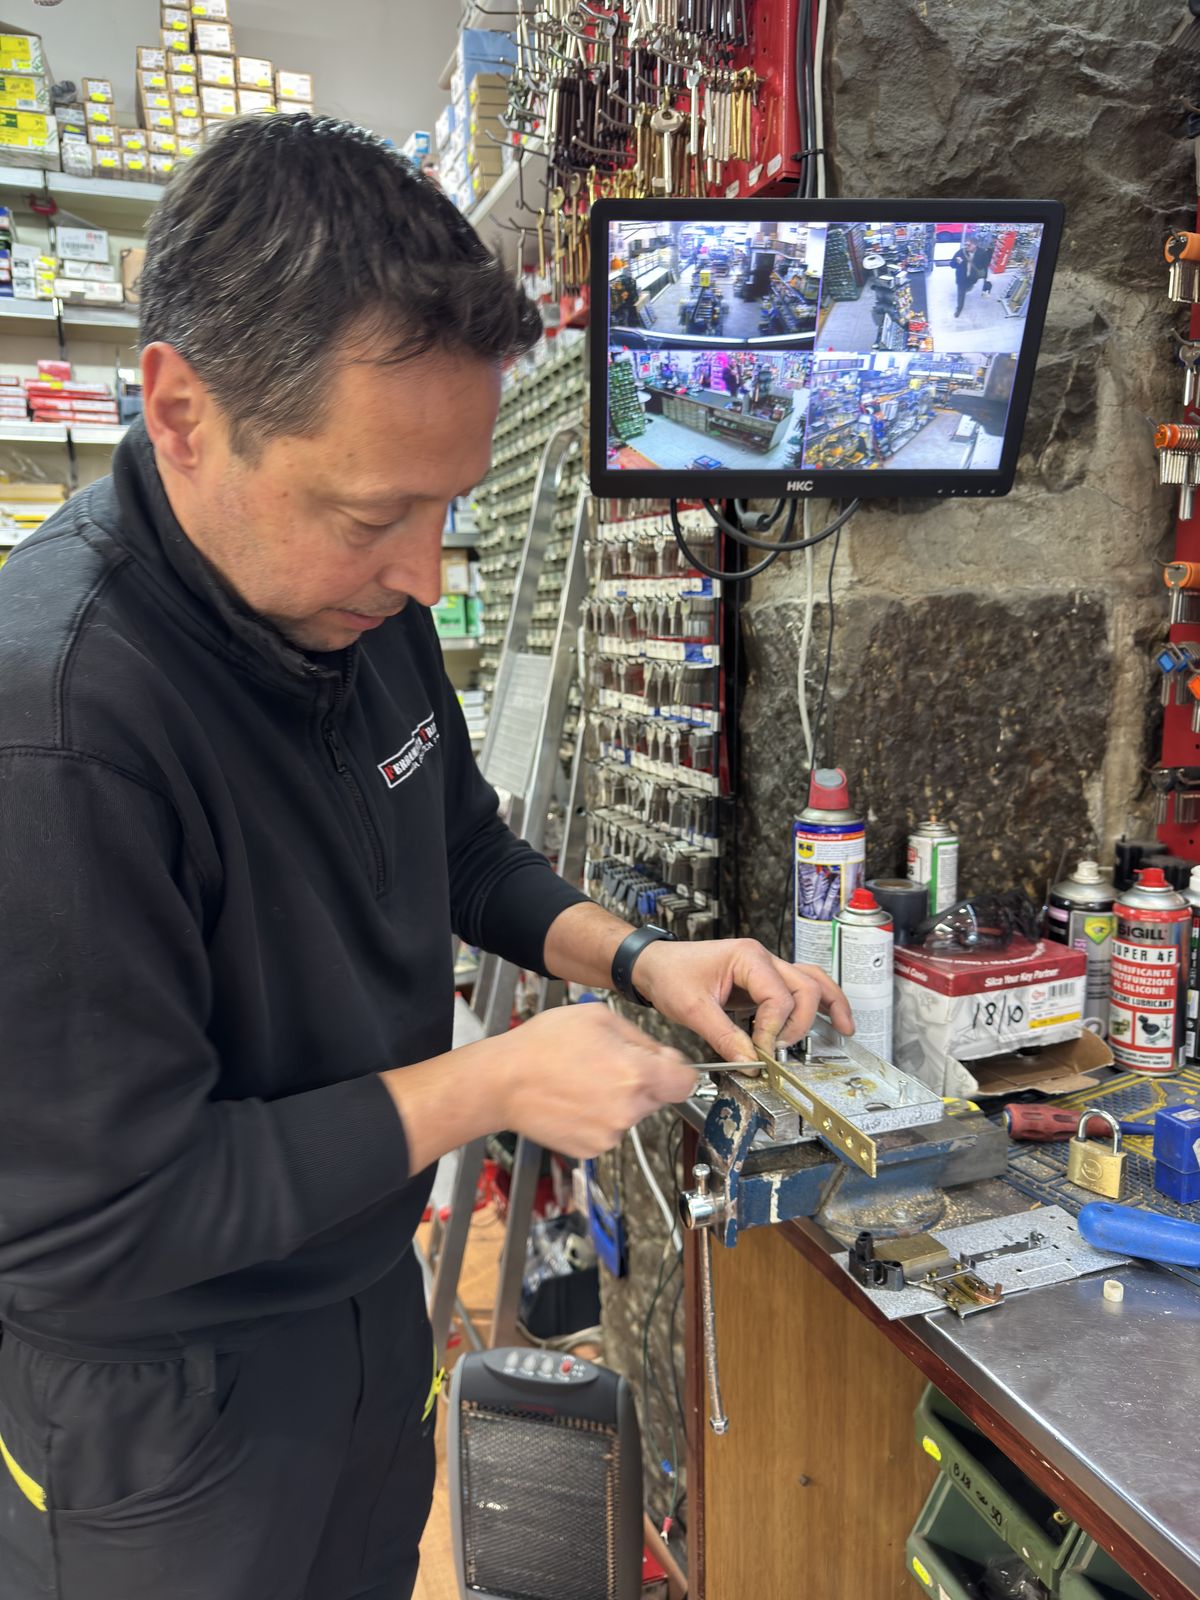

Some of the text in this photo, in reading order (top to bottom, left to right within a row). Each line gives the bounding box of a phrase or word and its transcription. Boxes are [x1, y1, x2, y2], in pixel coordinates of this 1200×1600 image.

[787, 481, 814, 491] HKC
[1157, 950, 1174, 963] 4F
[1123, 982, 1166, 995] SILICONE
[973, 995, 1024, 1033] 18/10
